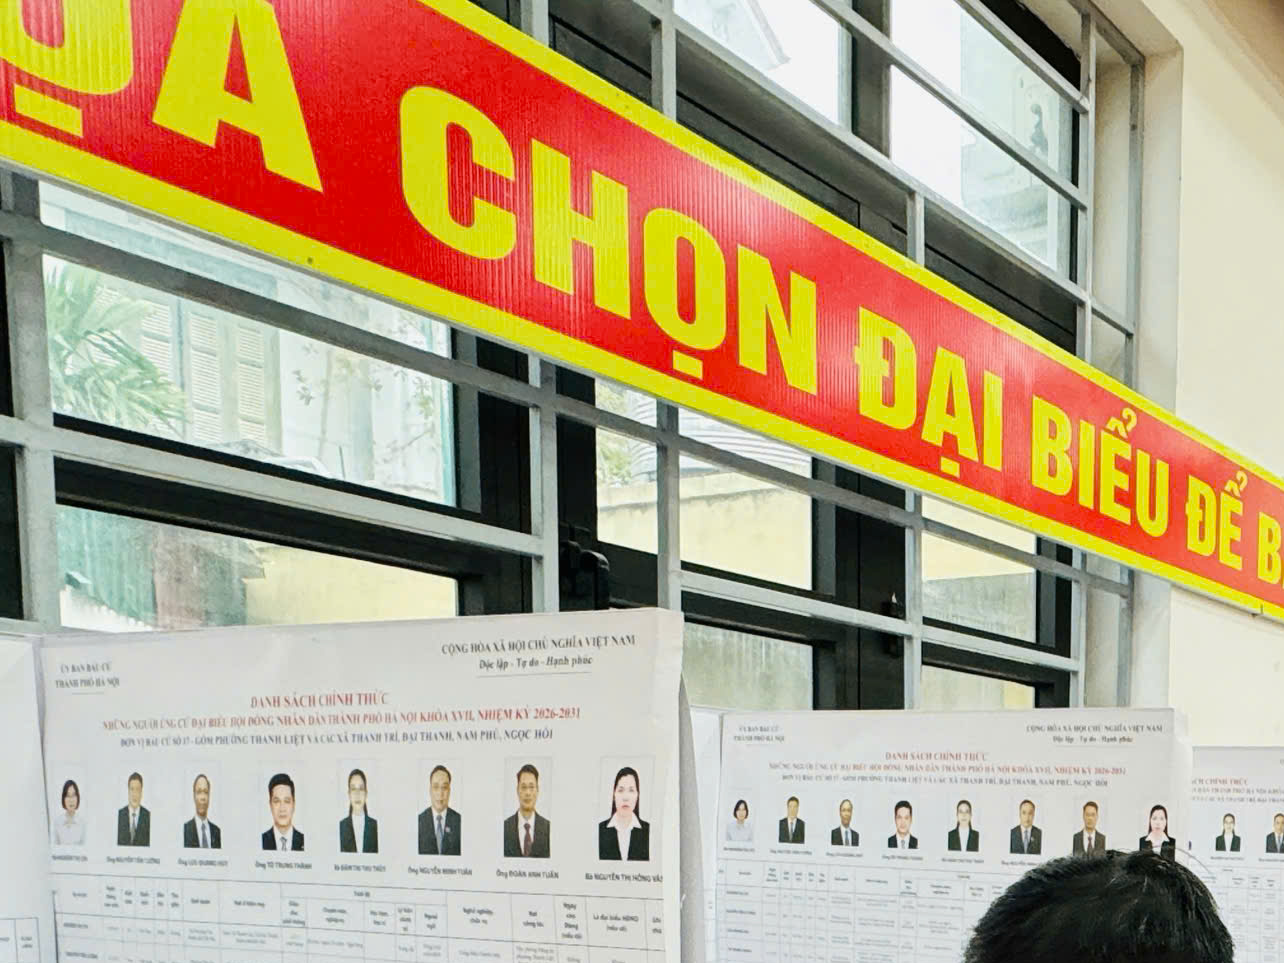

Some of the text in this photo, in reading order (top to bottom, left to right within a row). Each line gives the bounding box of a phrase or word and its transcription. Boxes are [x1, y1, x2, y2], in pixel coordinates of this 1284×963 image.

[399, 86, 818, 396] CHỌN
[856, 305, 1003, 479] ĐẠI
[1031, 395, 1169, 538] BIỂU
[1185, 470, 1249, 571] ĐỂ
[441, 634, 636, 656] CỘNG HÒA XÃ HỘI CHỦ NGHĨA VIỆT NAM
[546, 656, 569, 668] Hạnh
[250, 688, 389, 709] DANH SÁCH CHÍNH THỨC
[250, 734, 282, 745] THANH
[351, 732, 382, 744] THANH
[456, 729, 478, 741] NAM
